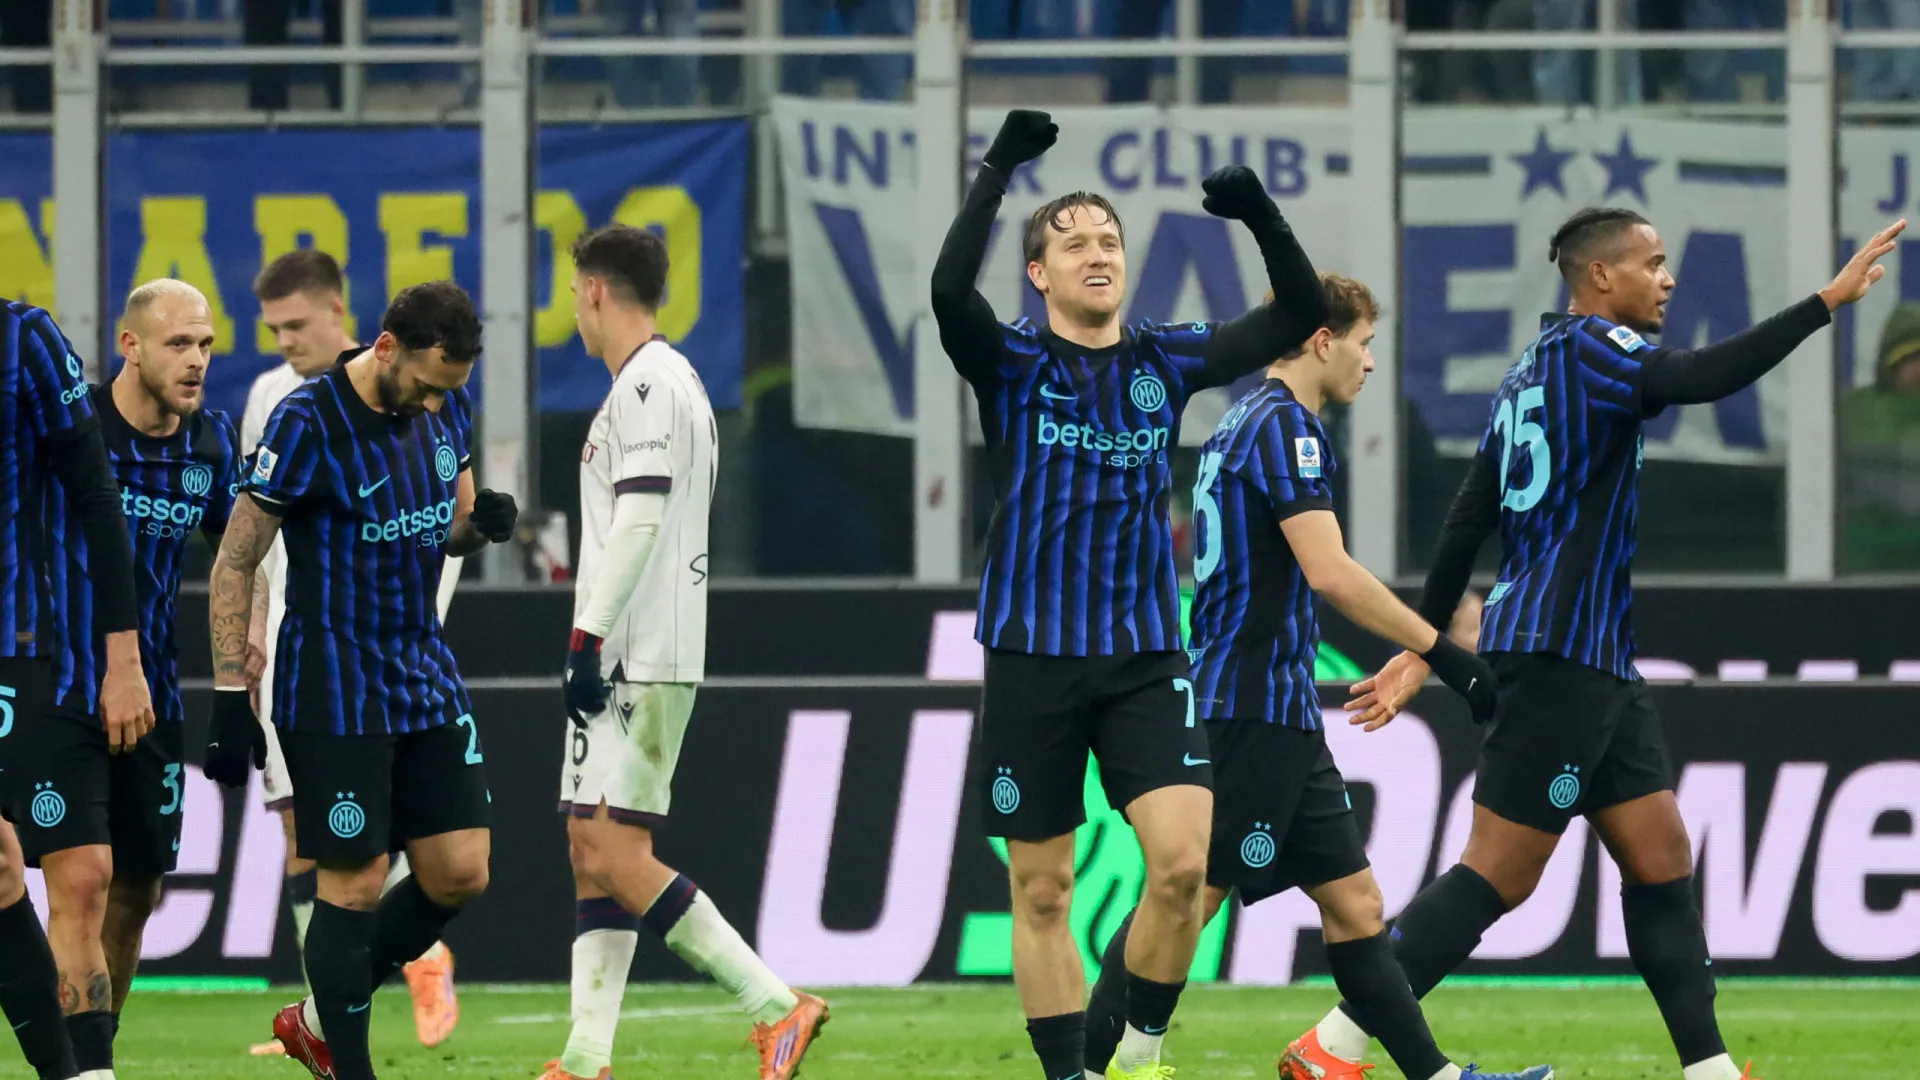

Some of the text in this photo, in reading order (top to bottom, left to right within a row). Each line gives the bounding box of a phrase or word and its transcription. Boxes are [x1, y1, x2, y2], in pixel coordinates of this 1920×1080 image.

[1098, 130, 1308, 197] CLUB
[1037, 414, 1169, 451] betsson
[120, 486, 203, 526] tsson
[1172, 677, 1195, 728] 7
